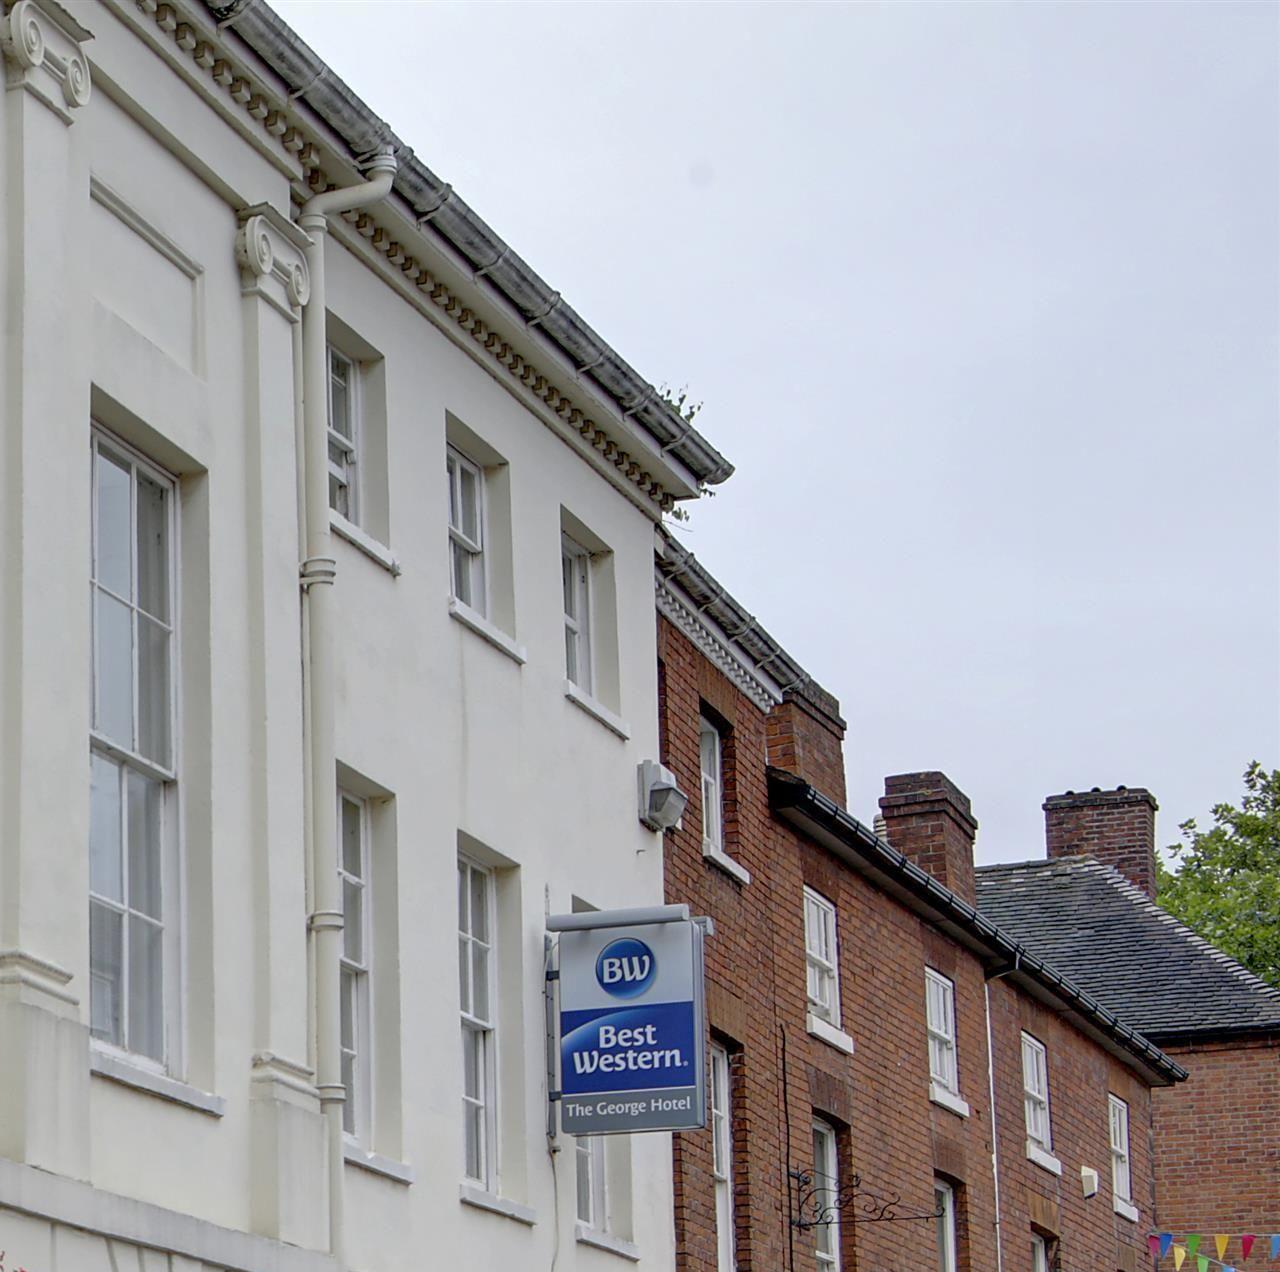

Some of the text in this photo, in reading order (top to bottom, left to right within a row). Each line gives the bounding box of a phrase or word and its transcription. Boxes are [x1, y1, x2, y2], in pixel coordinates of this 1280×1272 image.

[602, 955, 650, 984] BW
[599, 1024, 658, 1049] Best
[566, 1095, 691, 1118] The George Hotel
